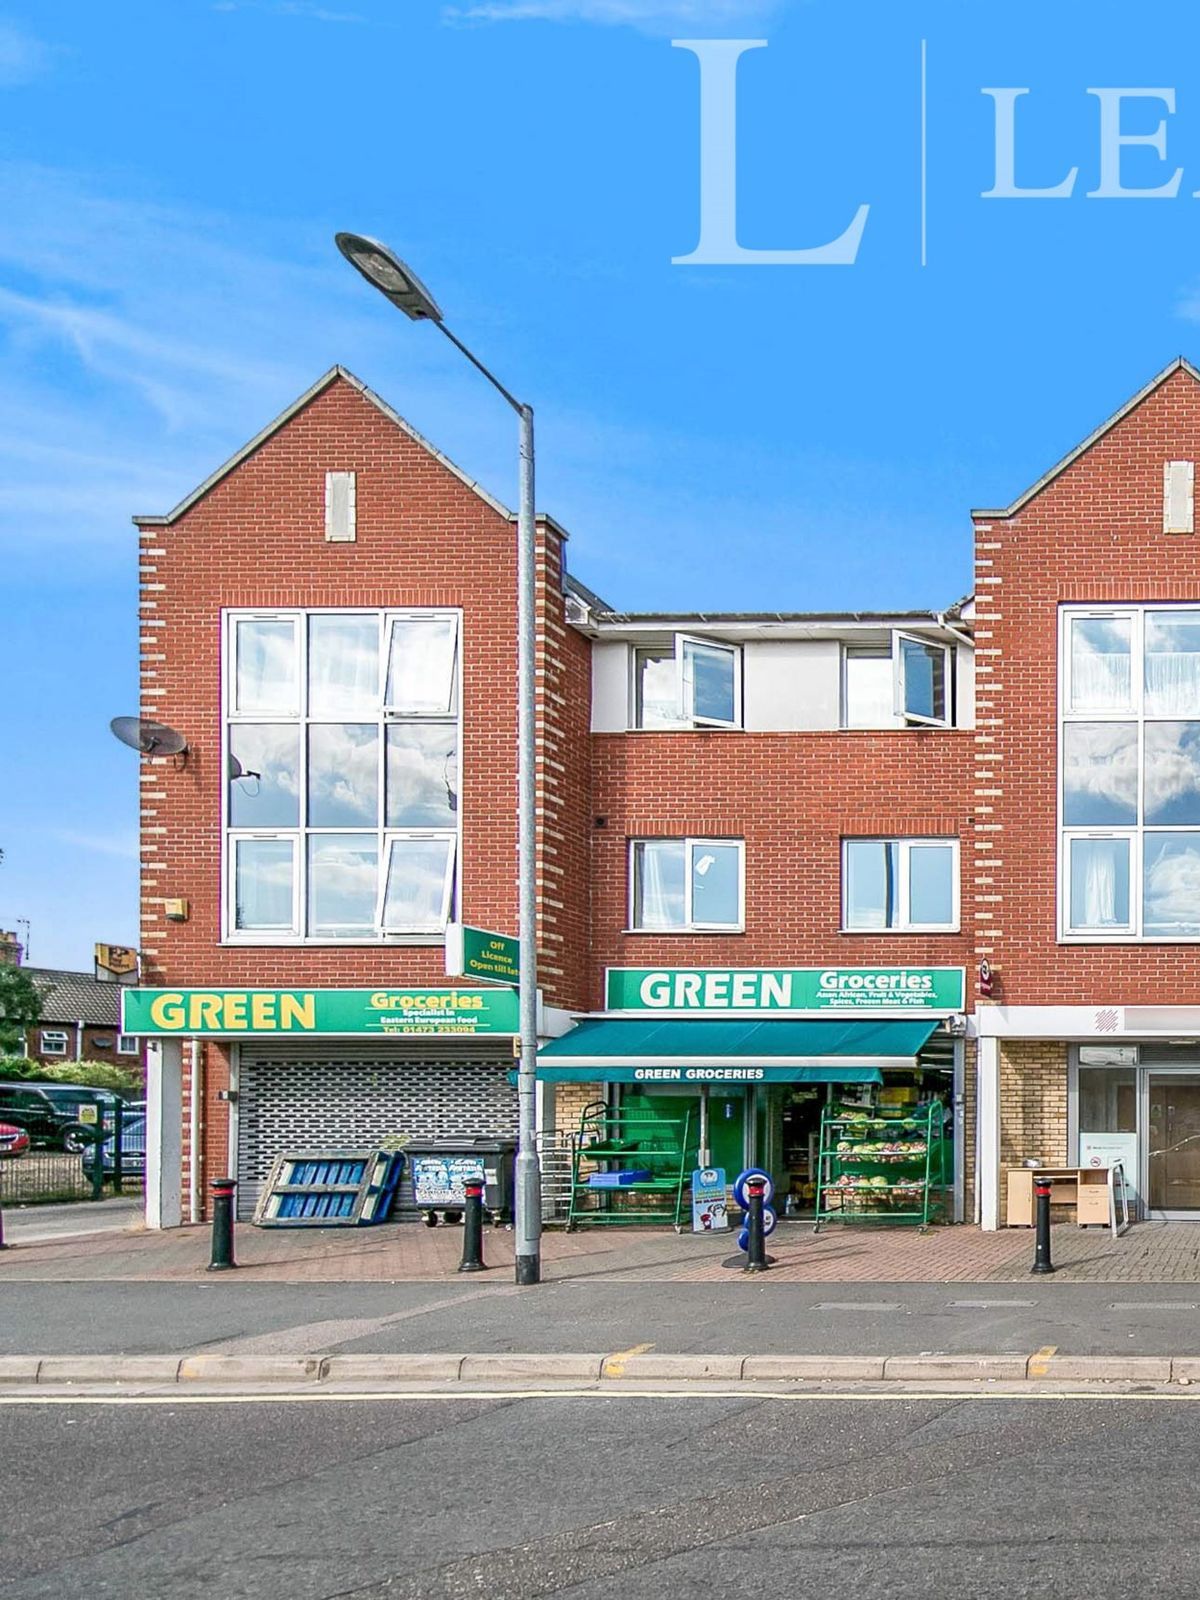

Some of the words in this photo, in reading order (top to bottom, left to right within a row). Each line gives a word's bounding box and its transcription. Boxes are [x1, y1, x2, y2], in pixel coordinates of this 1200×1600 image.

[490, 941, 505, 951] Off
[481, 950, 513, 964] Licence
[469, 959, 494, 971] Open
[508, 967, 520, 976] lat
[820, 971, 933, 989] Groceries
[640, 972, 793, 1008] GREEN
[370, 991, 484, 1009] Groceries
[151, 993, 316, 1030] GREEN
[403, 1009, 444, 1017] Specialist
[380, 1016, 414, 1024] Eastern
[415, 1016, 456, 1025] European
[634, 1069, 680, 1079] GREEN
[685, 1069, 764, 1079] GROCERIES
